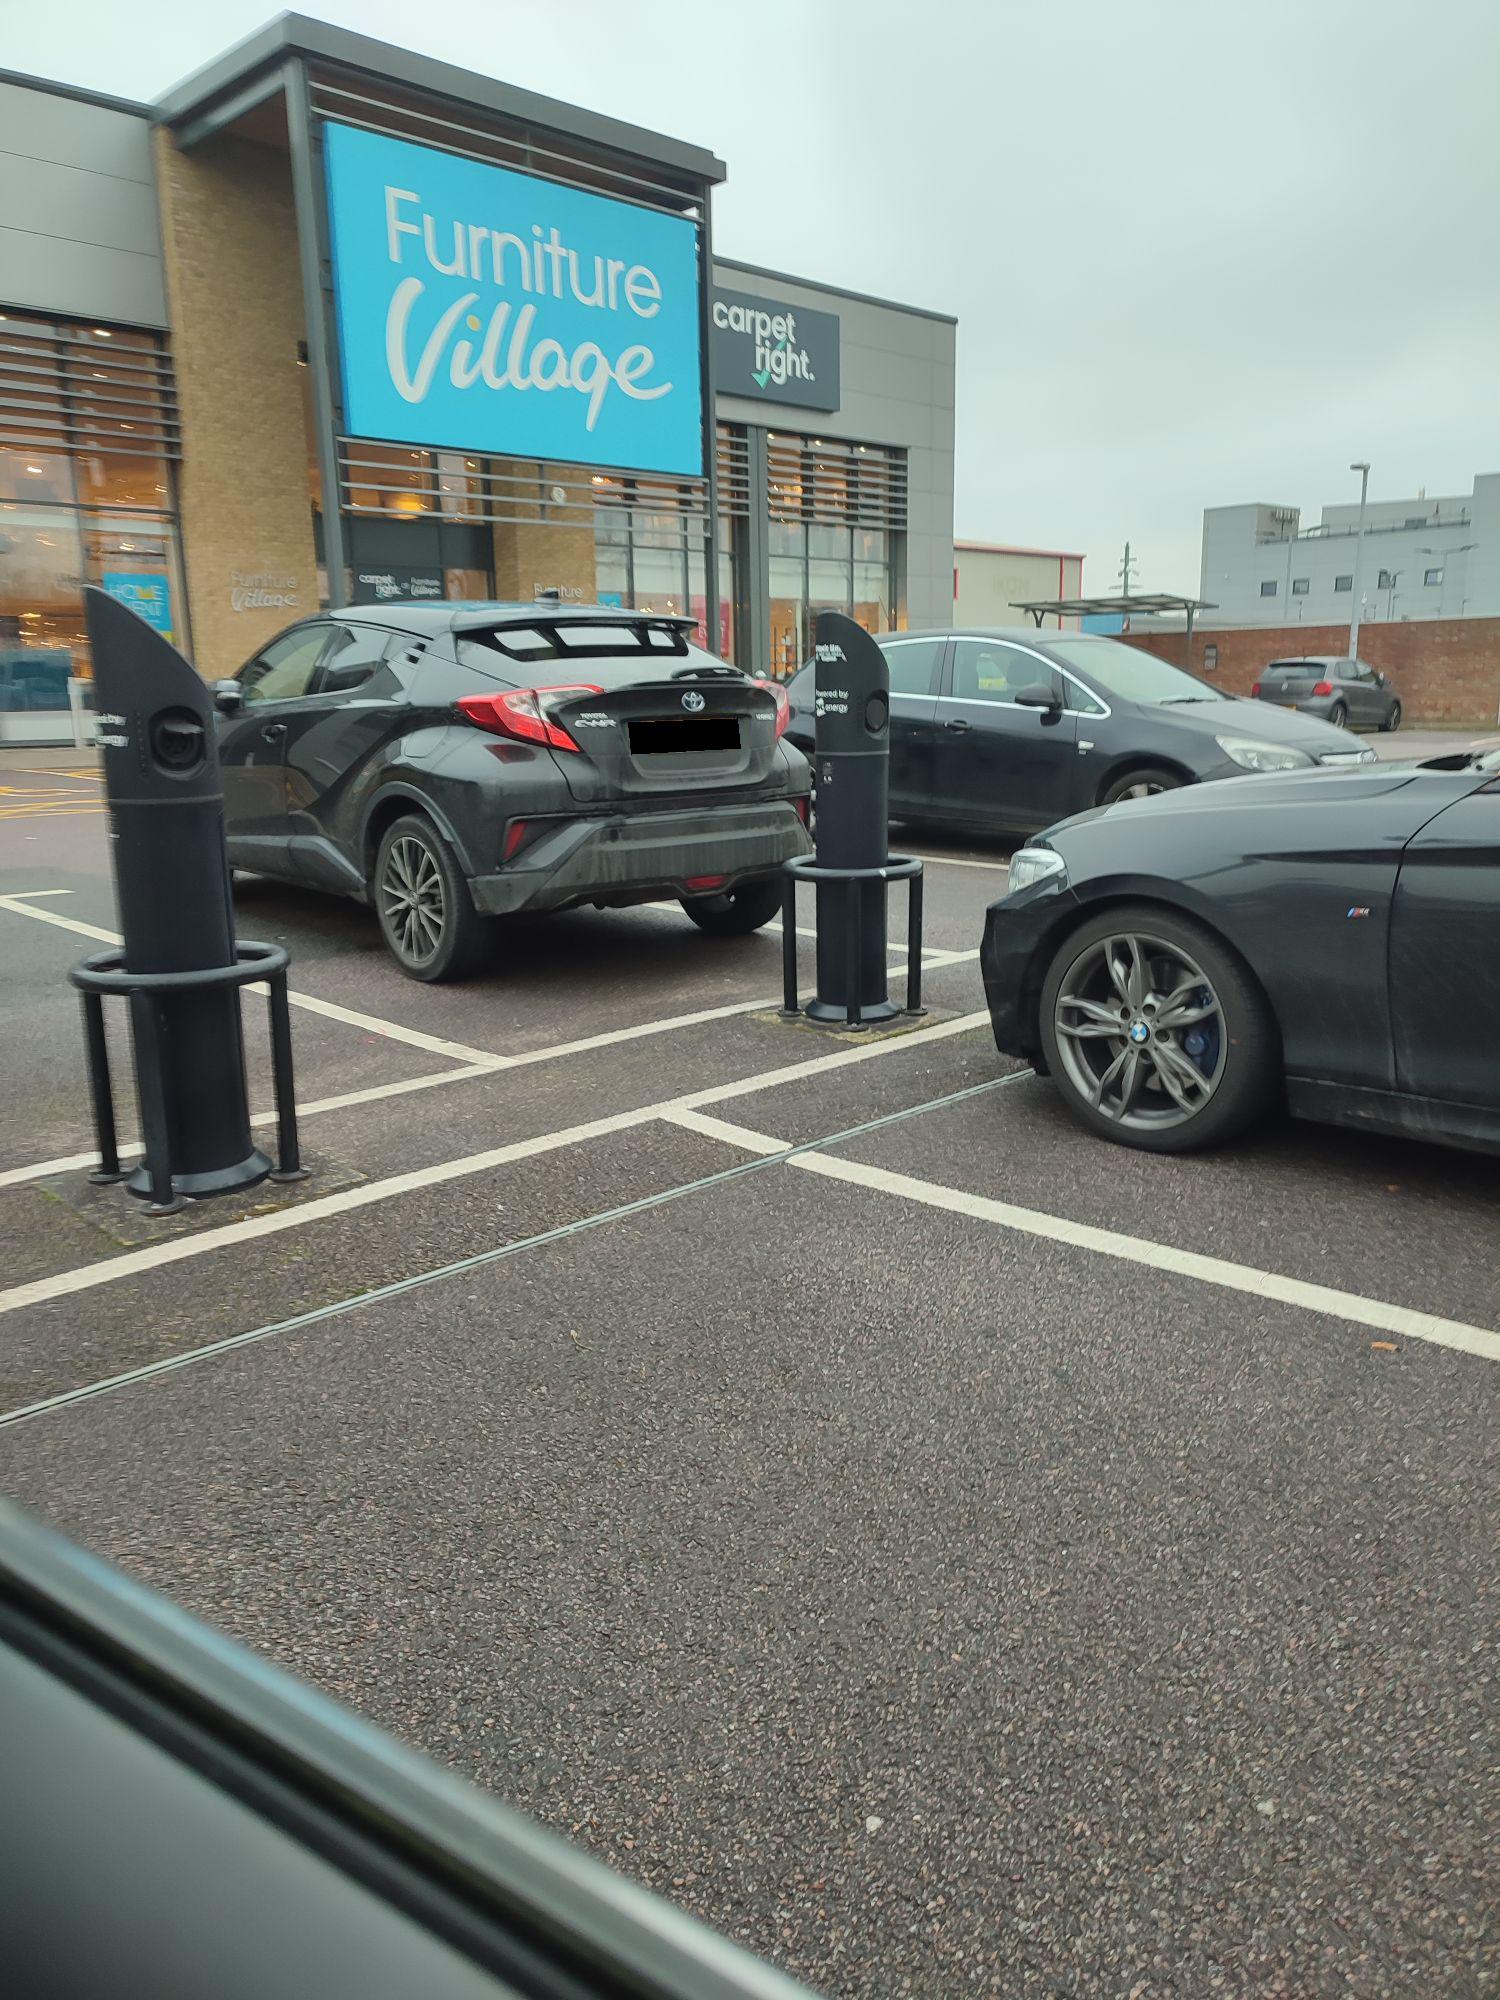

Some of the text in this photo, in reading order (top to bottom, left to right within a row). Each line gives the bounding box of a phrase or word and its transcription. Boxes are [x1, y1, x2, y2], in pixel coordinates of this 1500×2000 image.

[384, 185, 662, 319] Furniture
[713, 301, 796, 345] carpet
[386, 277, 674, 432] Village
[755, 340, 816, 385] right.
[231, 571, 297, 589] Furniture
[231, 588, 299, 612] Village
[359, 574, 395, 587] carpet
